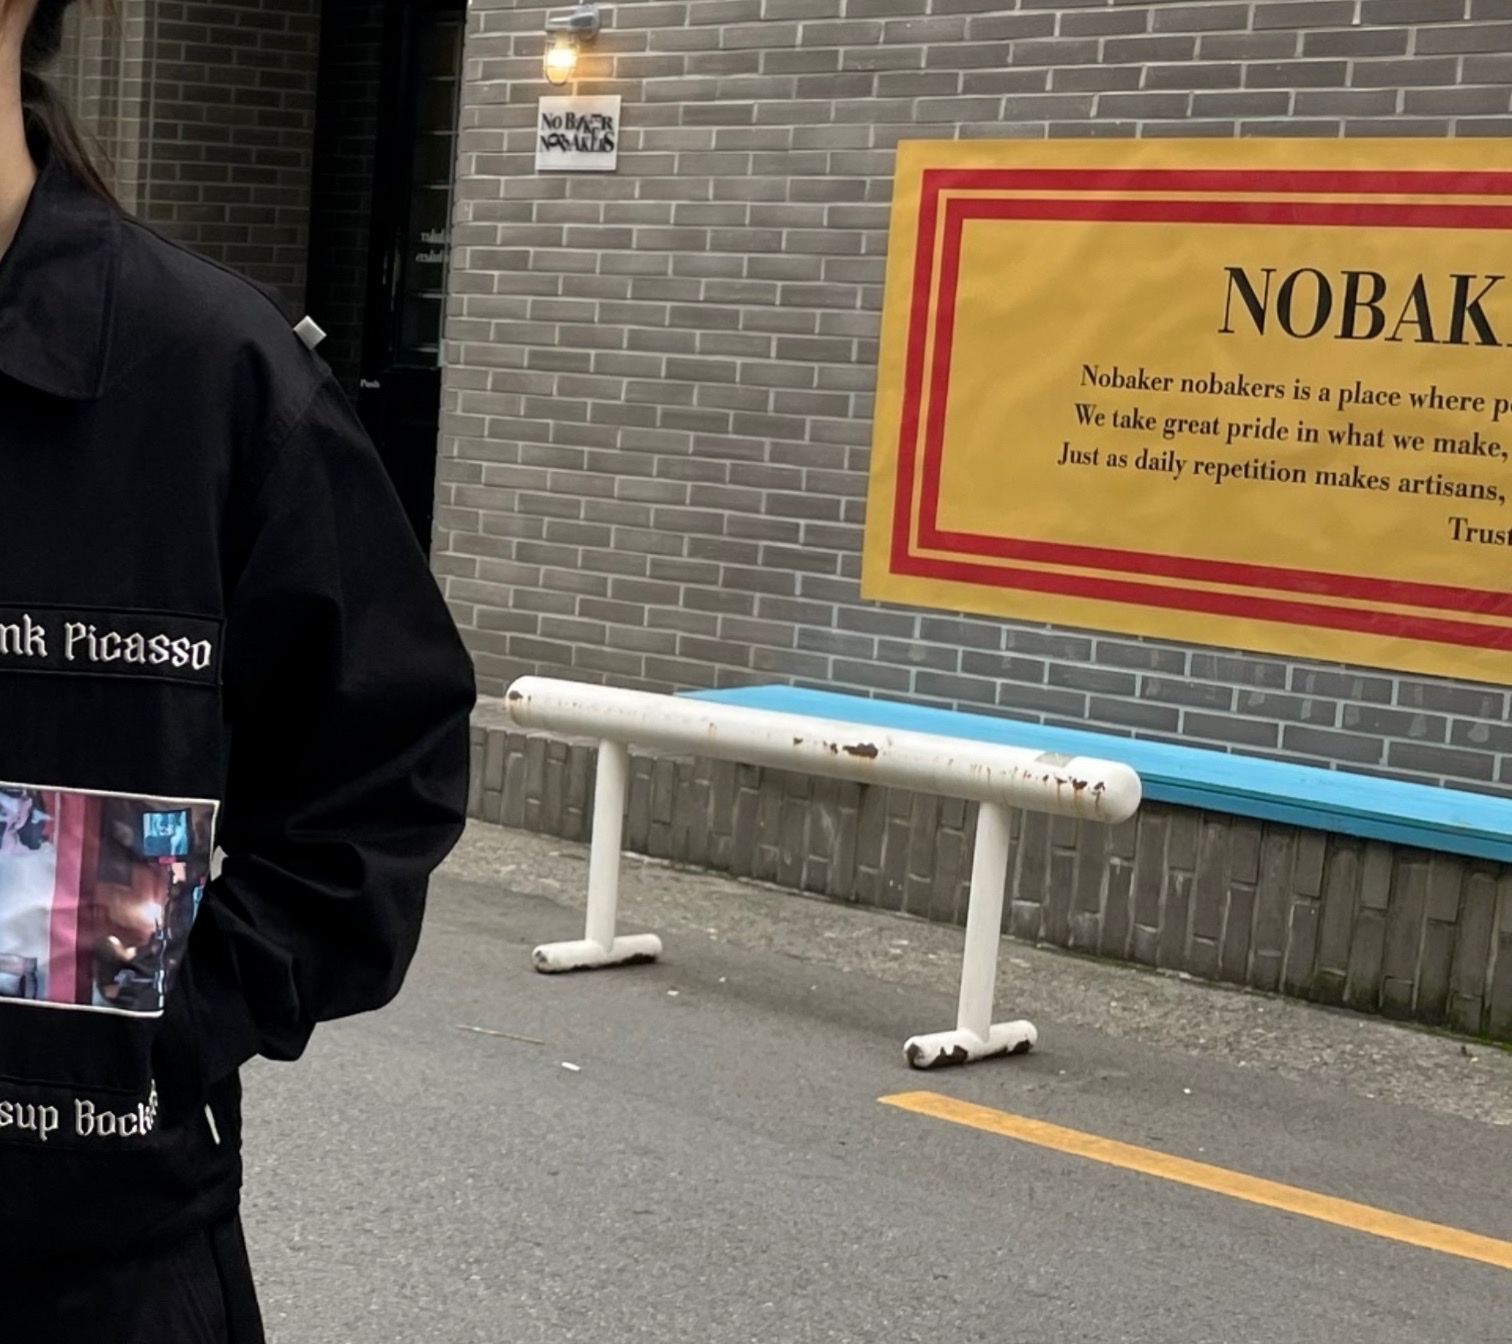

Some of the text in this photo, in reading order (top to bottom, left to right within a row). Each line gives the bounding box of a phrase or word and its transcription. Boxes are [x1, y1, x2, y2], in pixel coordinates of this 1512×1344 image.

[1218, 266, 1512, 348] NOBAK
[1080, 364, 1174, 392] Nobaker
[1180, 371, 1286, 400] nobakers
[1292, 378, 1311, 402] is
[1317, 387, 1331, 403] a
[1337, 380, 1402, 412] place
[1408, 385, 1486, 413] where
[1074, 403, 1509, 464] We take great pride in what we make,
[1057, 441, 1507, 505] Just as daily repetition makes artisans,
[65, 621, 213, 671] Picasso
